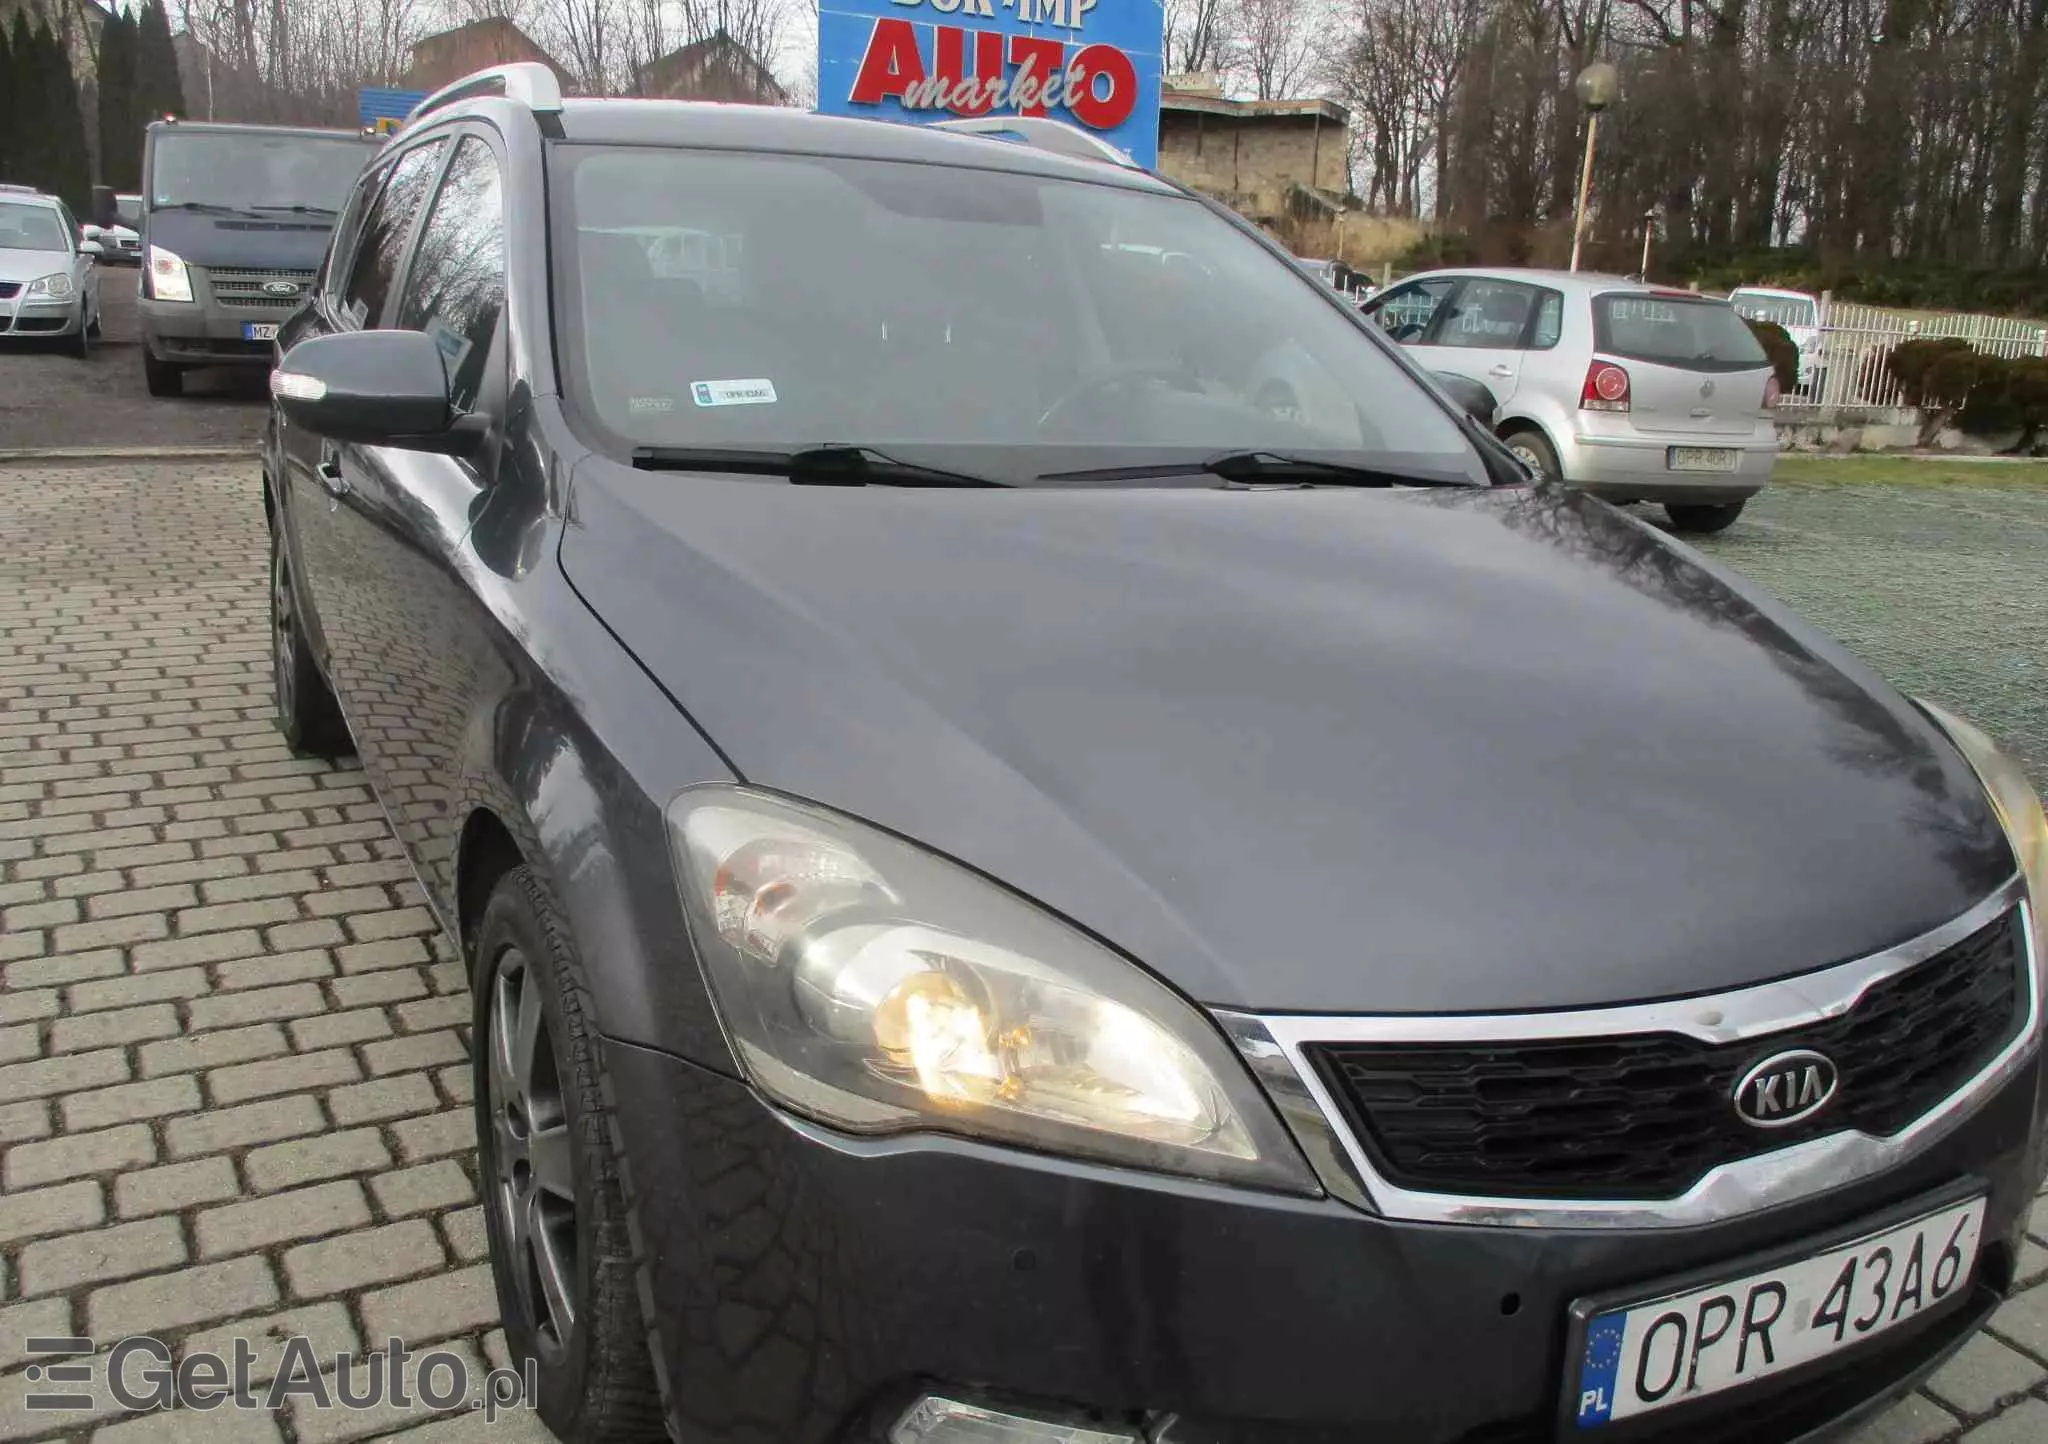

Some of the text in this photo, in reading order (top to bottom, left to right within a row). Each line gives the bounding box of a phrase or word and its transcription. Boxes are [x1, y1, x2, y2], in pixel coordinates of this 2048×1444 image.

[848, 17, 1137, 130] AUTO
[903, 52, 1086, 109] market
[1755, 1064, 1822, 1117] KIA
[1635, 1213, 1969, 1402] OPR 43A6
[1580, 1387, 1608, 1416] PL
